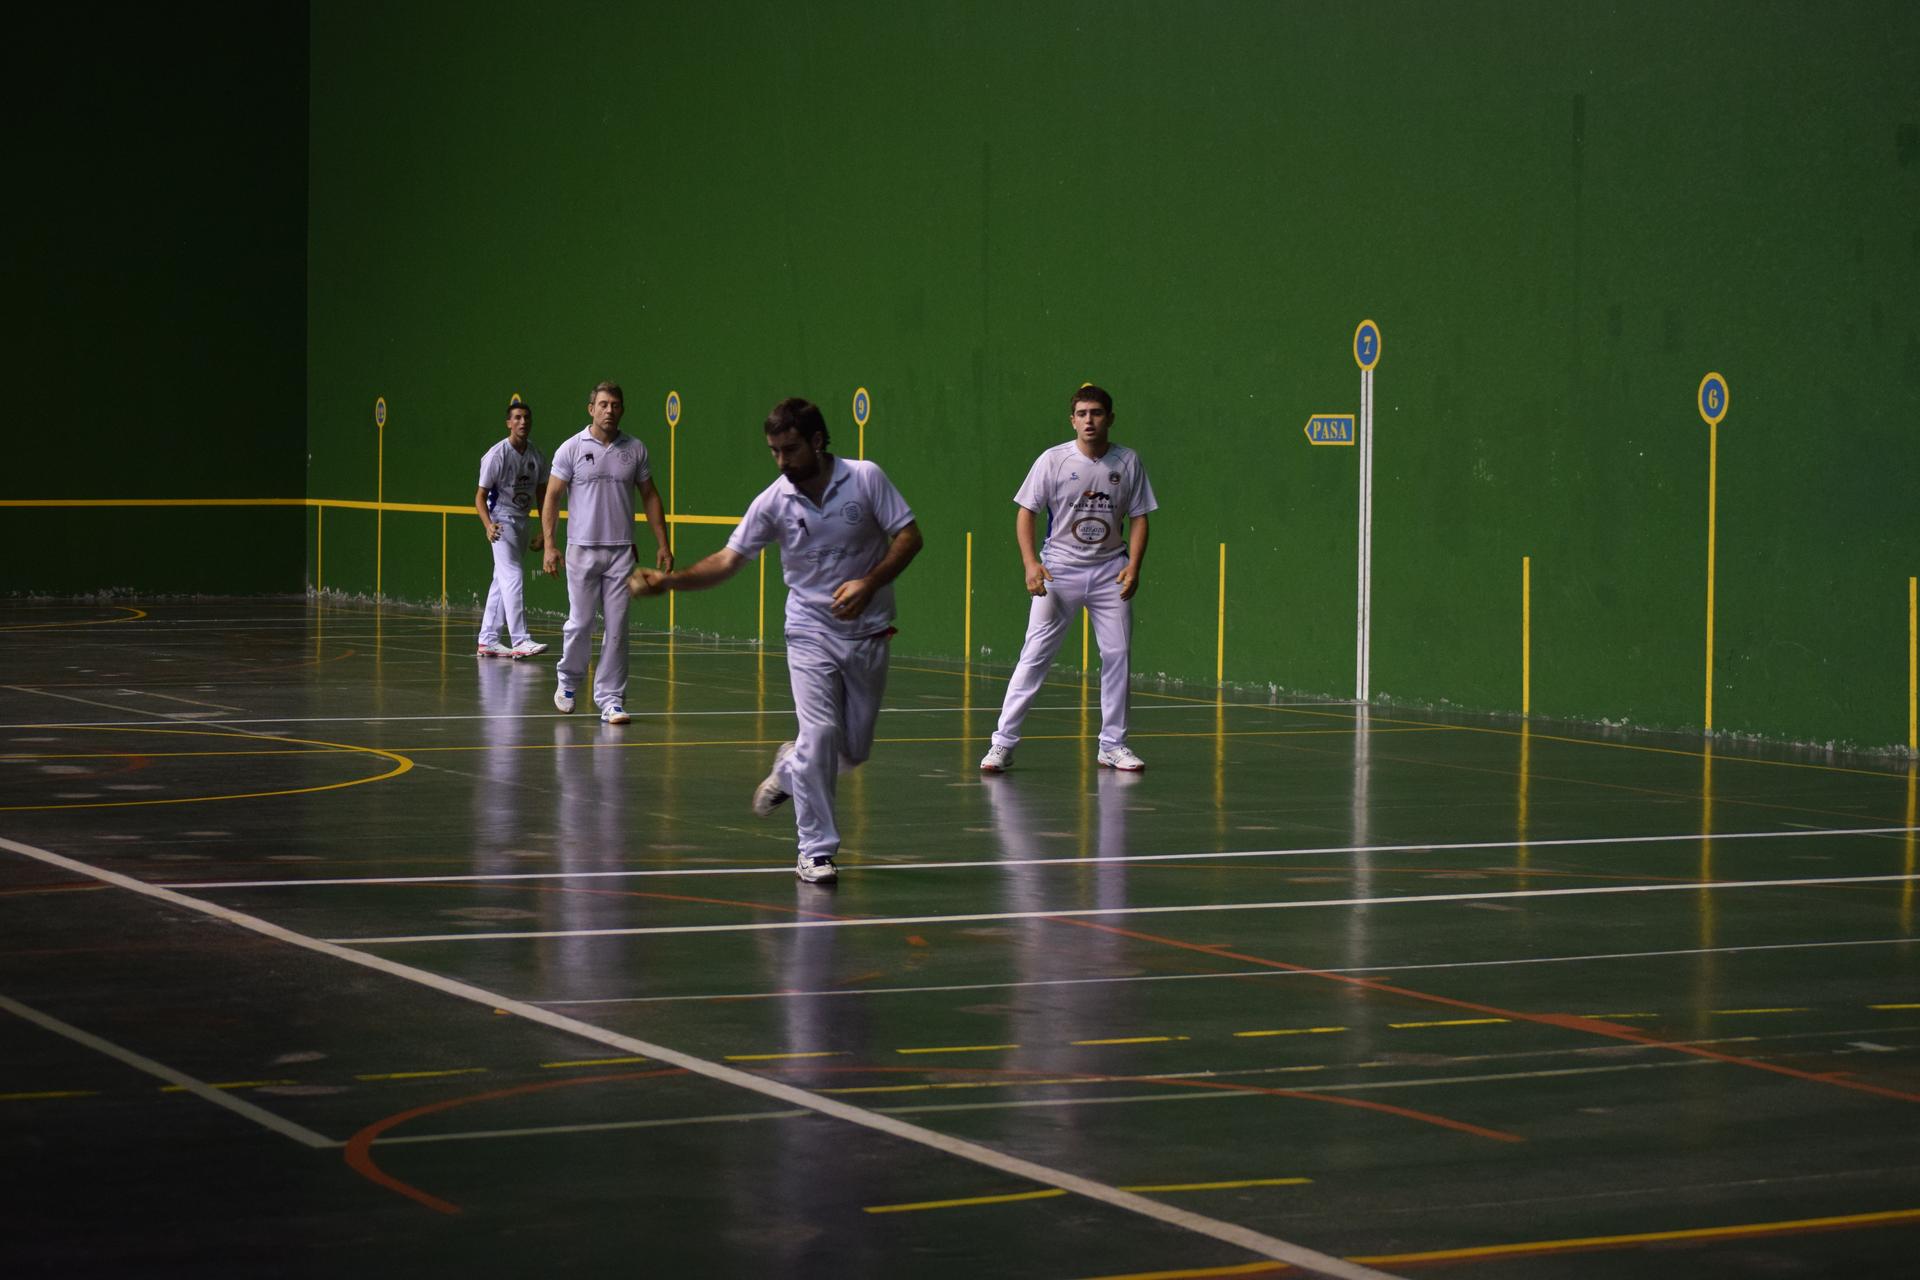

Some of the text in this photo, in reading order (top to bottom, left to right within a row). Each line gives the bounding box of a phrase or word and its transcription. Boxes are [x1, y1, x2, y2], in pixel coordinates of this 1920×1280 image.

[1363, 336, 1372, 355] 7
[858, 399, 865, 415] 9
[1708, 389, 1719, 409] 6
[669, 402, 678, 416] 10
[1313, 421, 1347, 439] PASA
